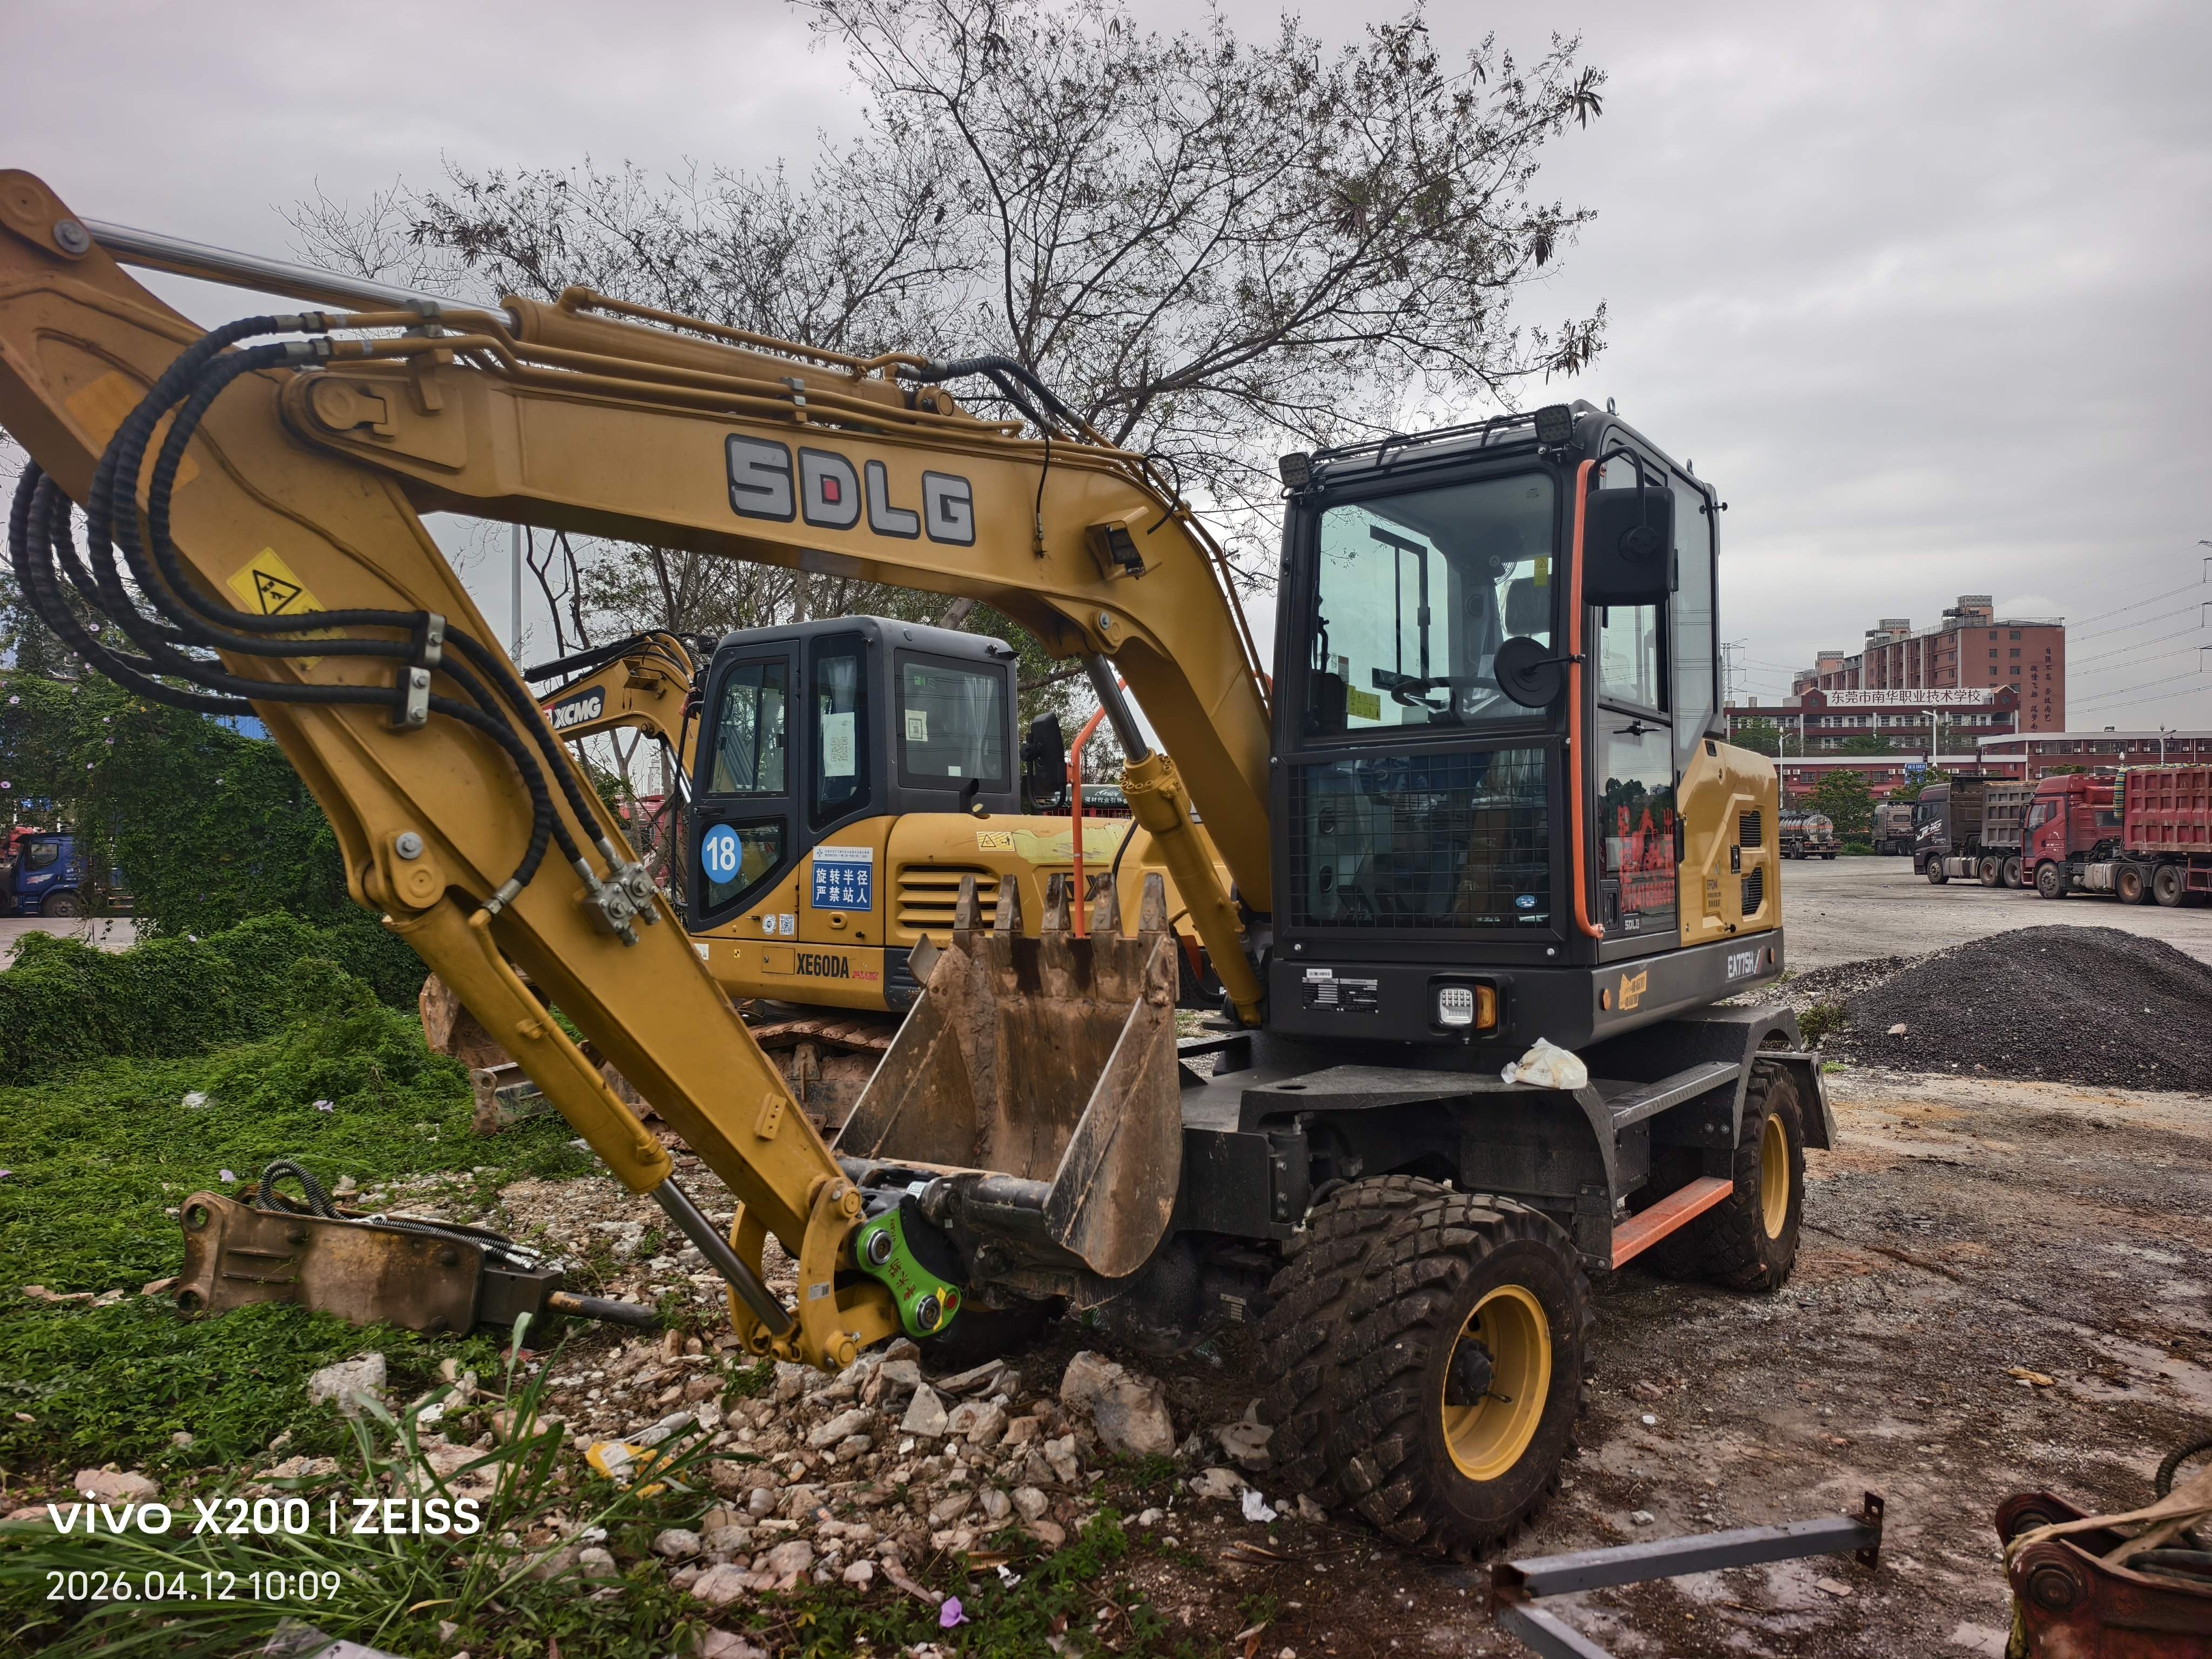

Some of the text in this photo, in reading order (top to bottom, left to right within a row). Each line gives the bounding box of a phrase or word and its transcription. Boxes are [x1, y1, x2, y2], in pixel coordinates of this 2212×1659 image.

[725, 433, 976, 547] SDLG
[1831, 690, 1981, 704] 东莞市南华职业技术学校
[553, 697, 601, 729] XCMG
[706, 837, 736, 871] 18
[816, 868, 868, 886] 旋转半径
[816, 886, 868, 903] 严禁站人
[1625, 919, 1640, 930] SDLG
[796, 953, 849, 979] XE60DA
